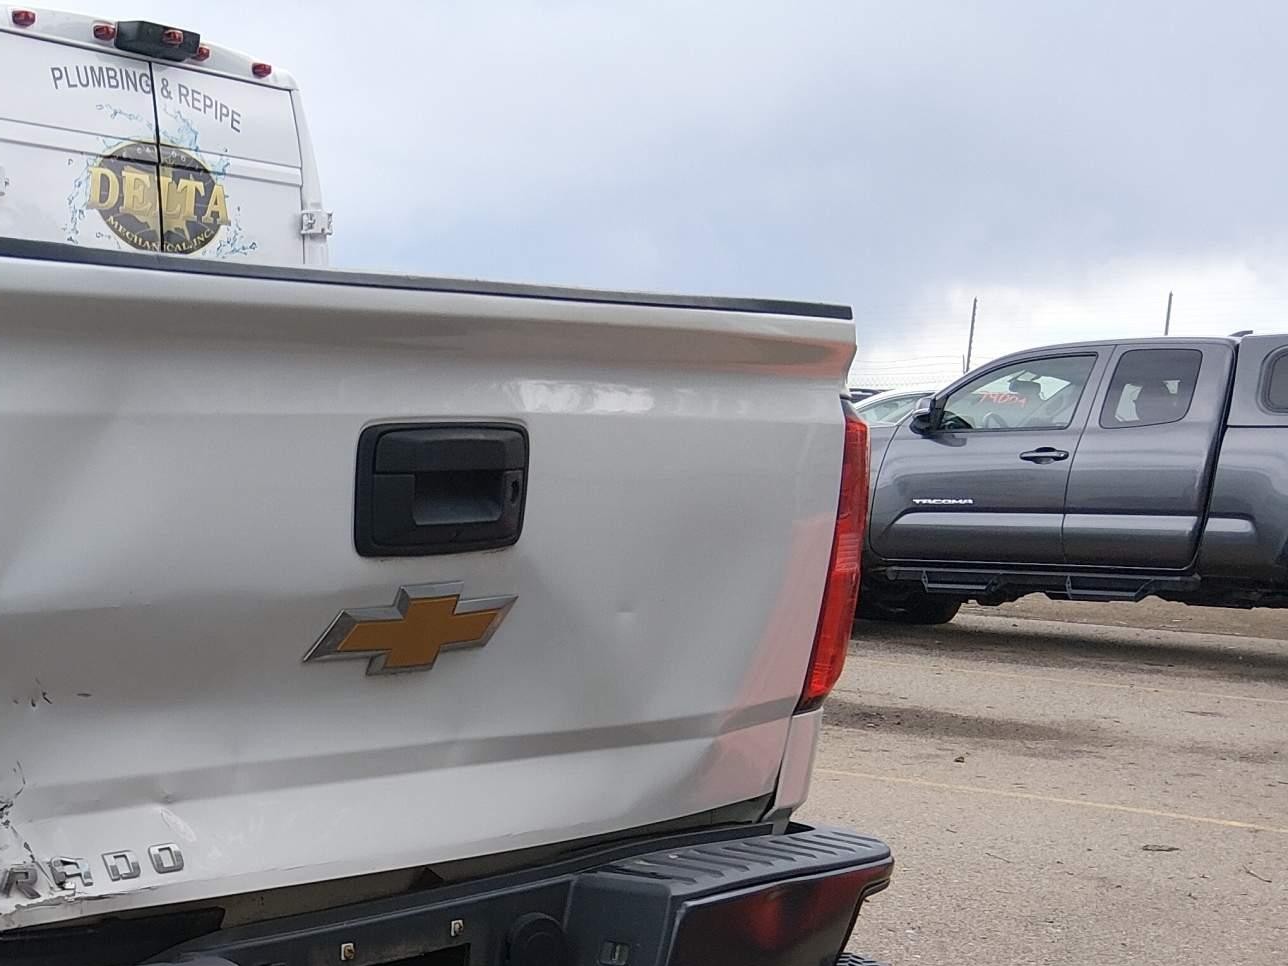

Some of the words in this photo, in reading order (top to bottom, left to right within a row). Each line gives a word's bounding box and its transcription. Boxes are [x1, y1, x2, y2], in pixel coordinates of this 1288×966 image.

[50, 65, 151, 95] PLUMBING
[161, 77, 173, 100] &
[178, 83, 241, 133] REPIPE
[87, 167, 231, 226] DELTA
